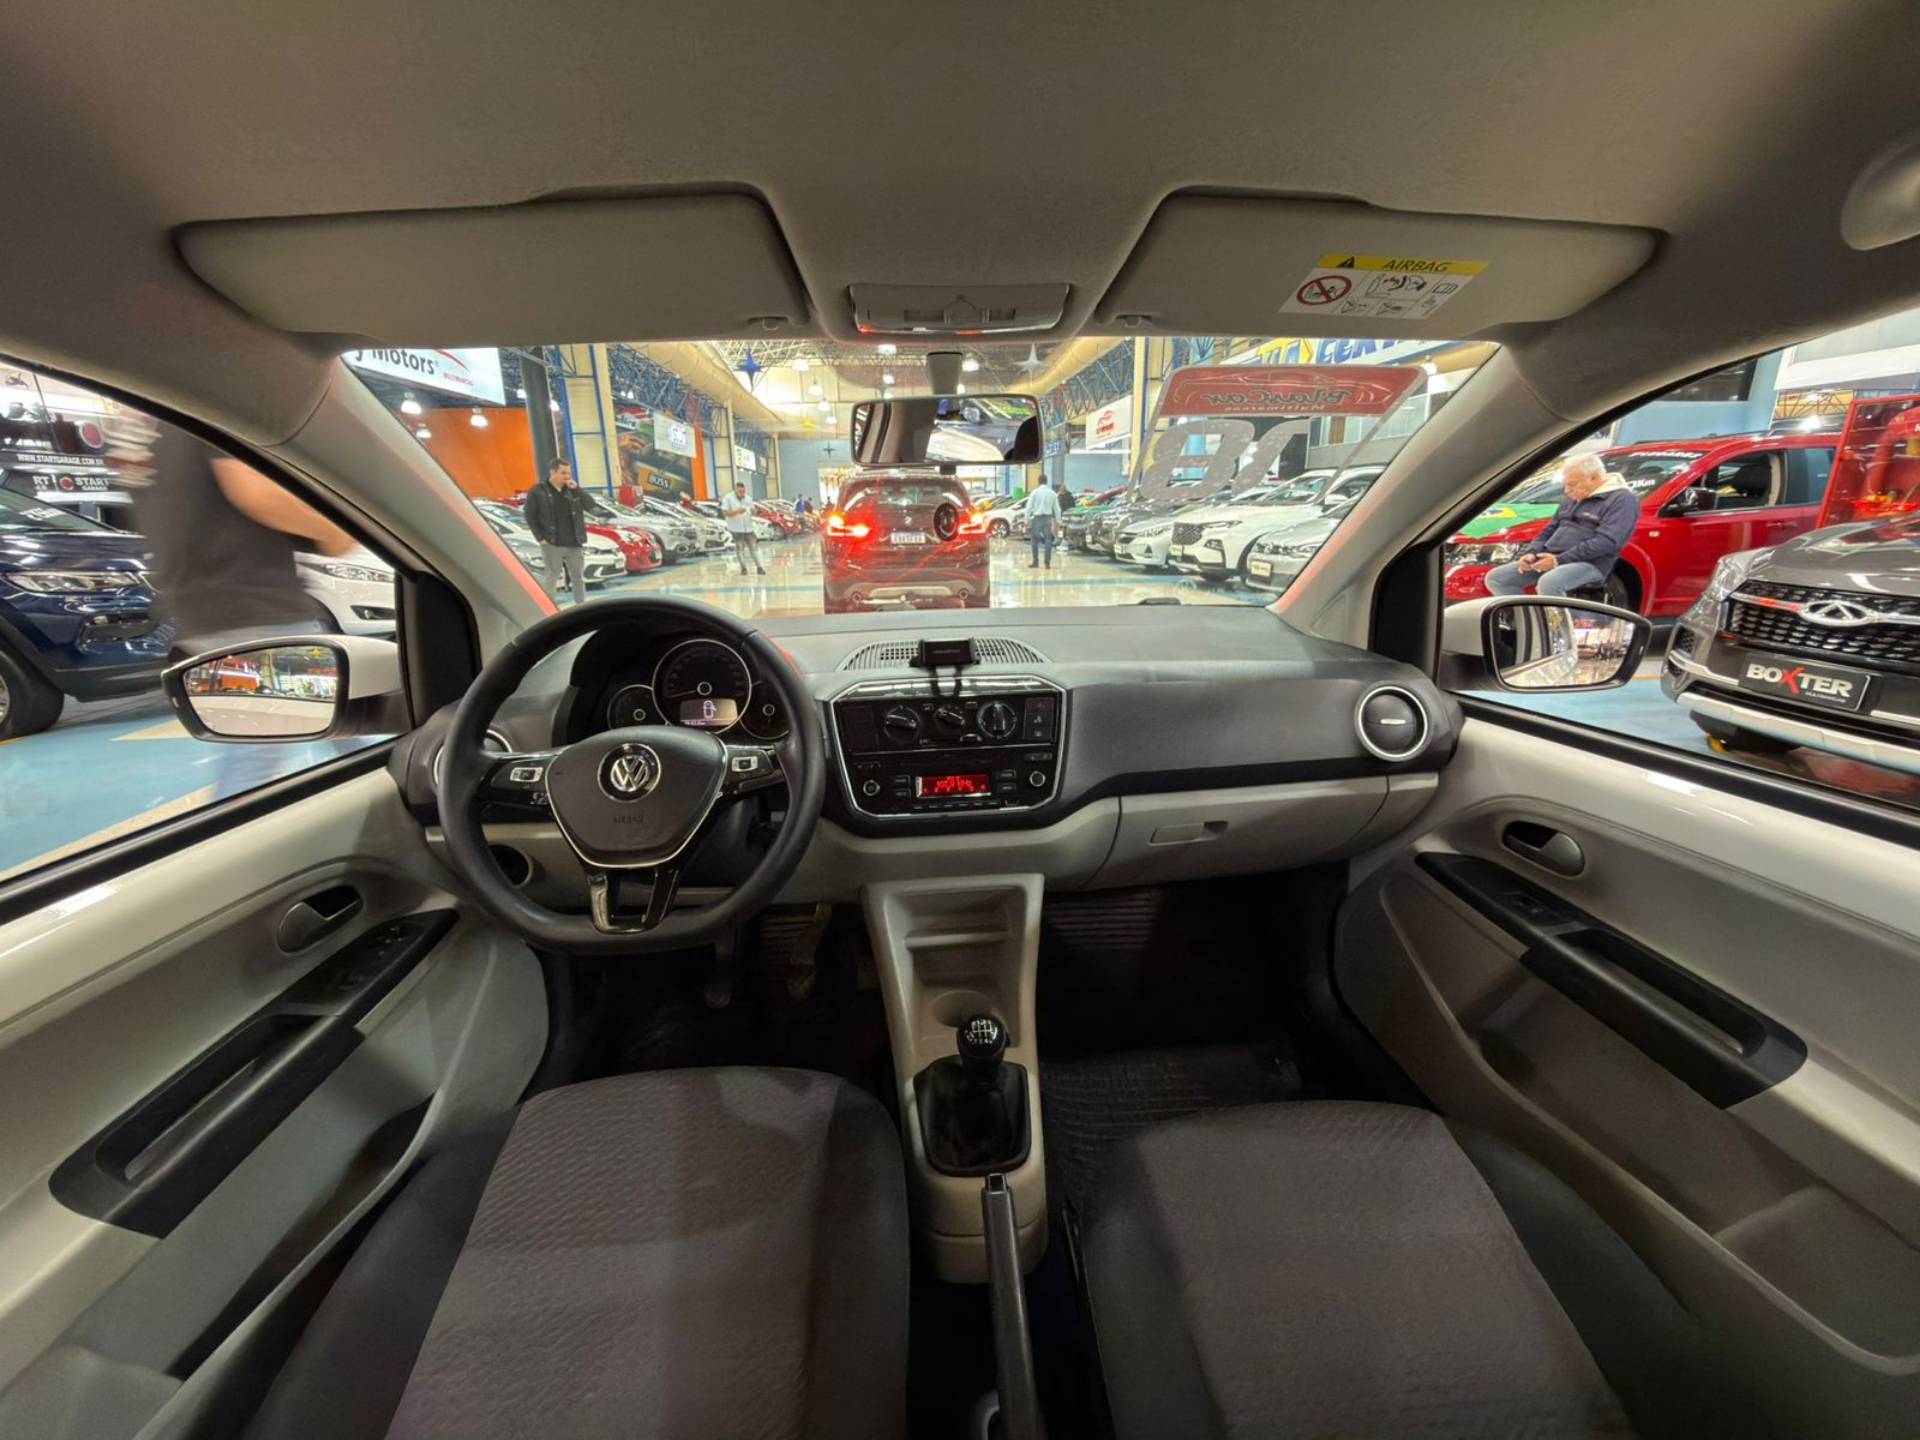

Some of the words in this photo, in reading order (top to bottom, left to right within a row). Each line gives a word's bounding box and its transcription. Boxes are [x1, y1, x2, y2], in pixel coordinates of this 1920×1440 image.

[1382, 259, 1452, 272] AIRBAG
[372, 349, 435, 375] Motors
[1745, 663, 1853, 698] BOXTER
